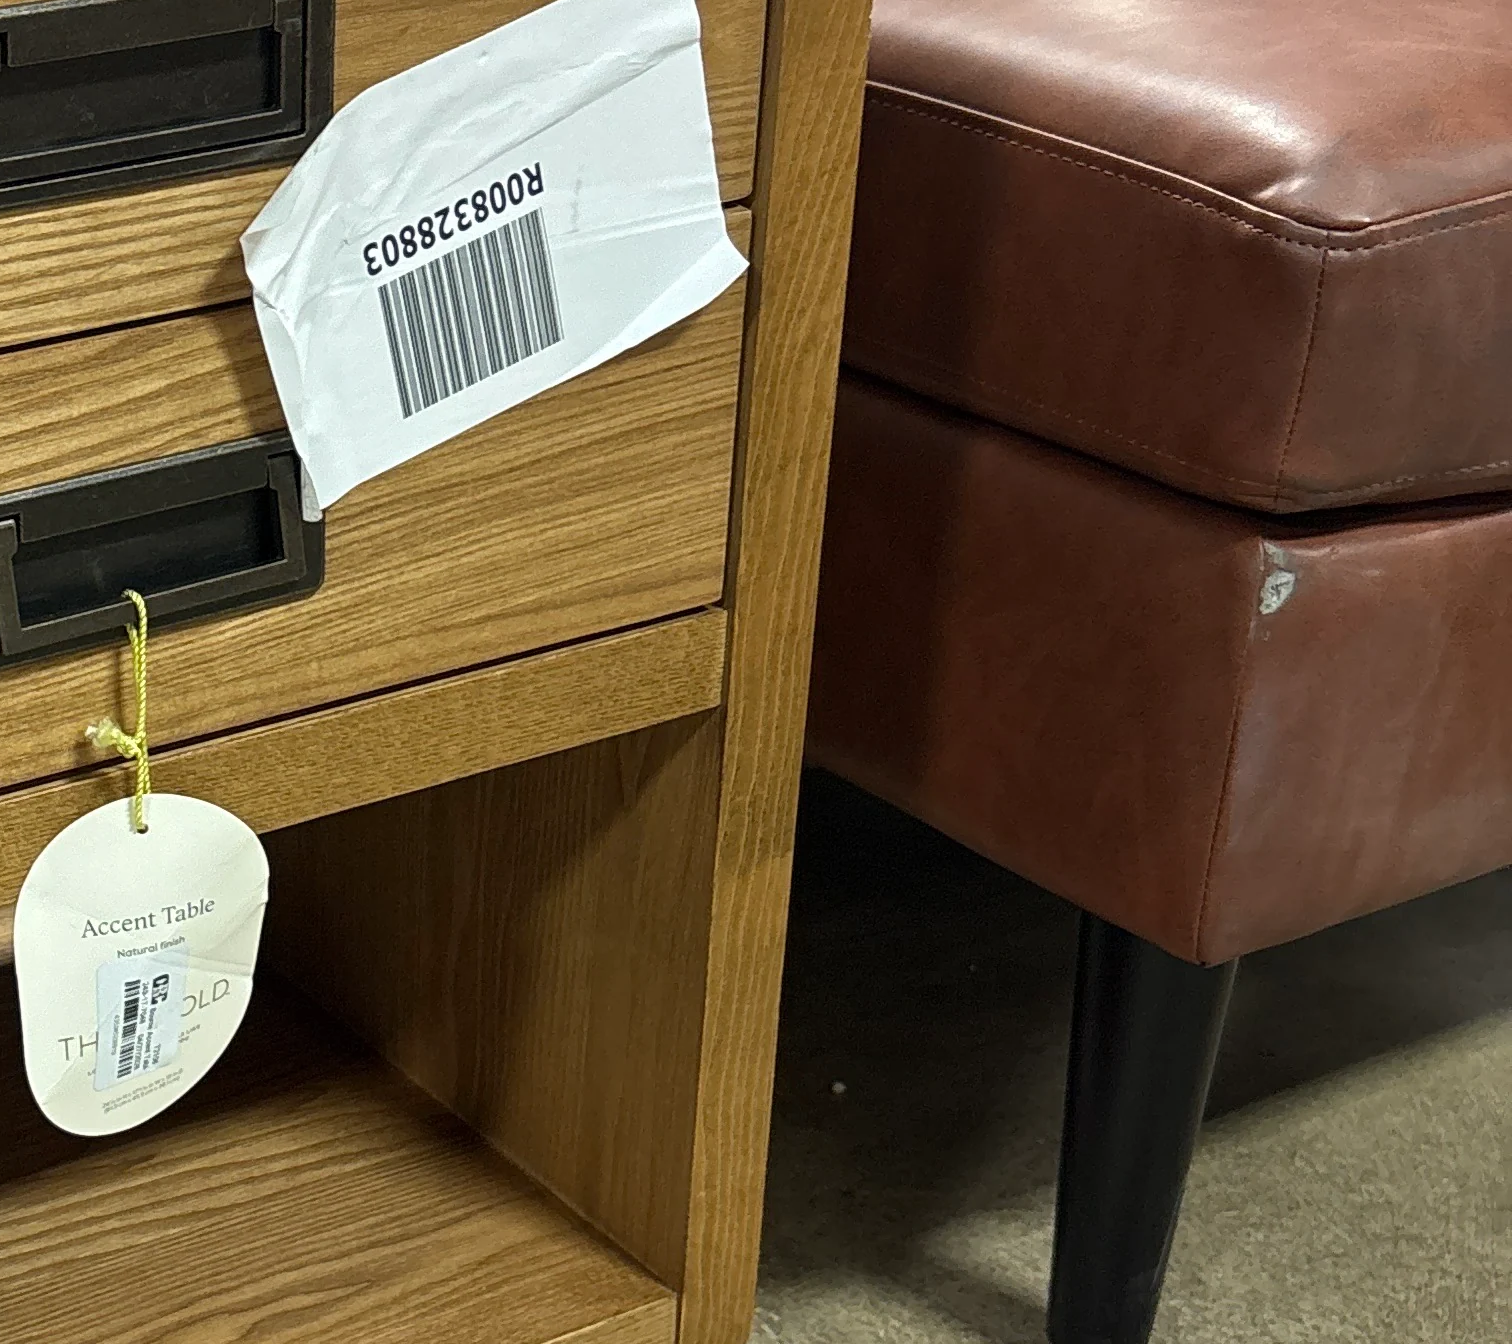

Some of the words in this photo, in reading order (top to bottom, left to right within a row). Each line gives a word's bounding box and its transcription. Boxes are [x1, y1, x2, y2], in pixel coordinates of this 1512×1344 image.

[362, 161, 544, 276] R008328803
[81, 912, 157, 939] Accent
[161, 898, 215, 924] Table
[117, 943, 158, 958] Natural
[160, 936, 186, 950] finish
